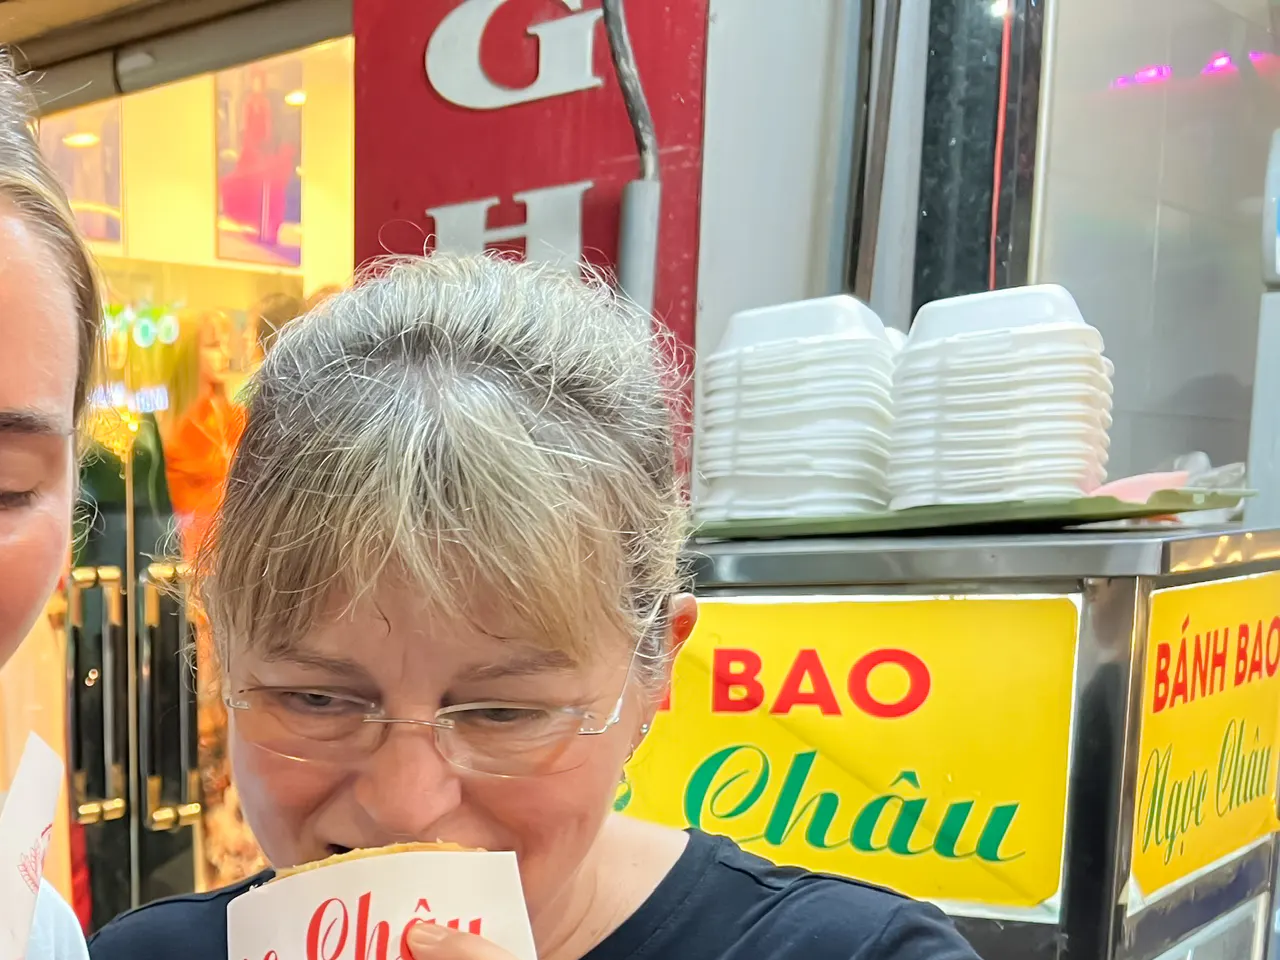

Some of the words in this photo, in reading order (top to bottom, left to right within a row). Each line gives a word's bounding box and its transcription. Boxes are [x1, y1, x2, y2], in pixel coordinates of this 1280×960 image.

[712, 648, 932, 718] BAO
[1152, 614, 1230, 713] BÁNH
[1234, 615, 1280, 687] BAO
[685, 744, 1027, 862] Châu
[1137, 743, 1209, 866] Ngọc
[1216, 718, 1272, 818] Châu
